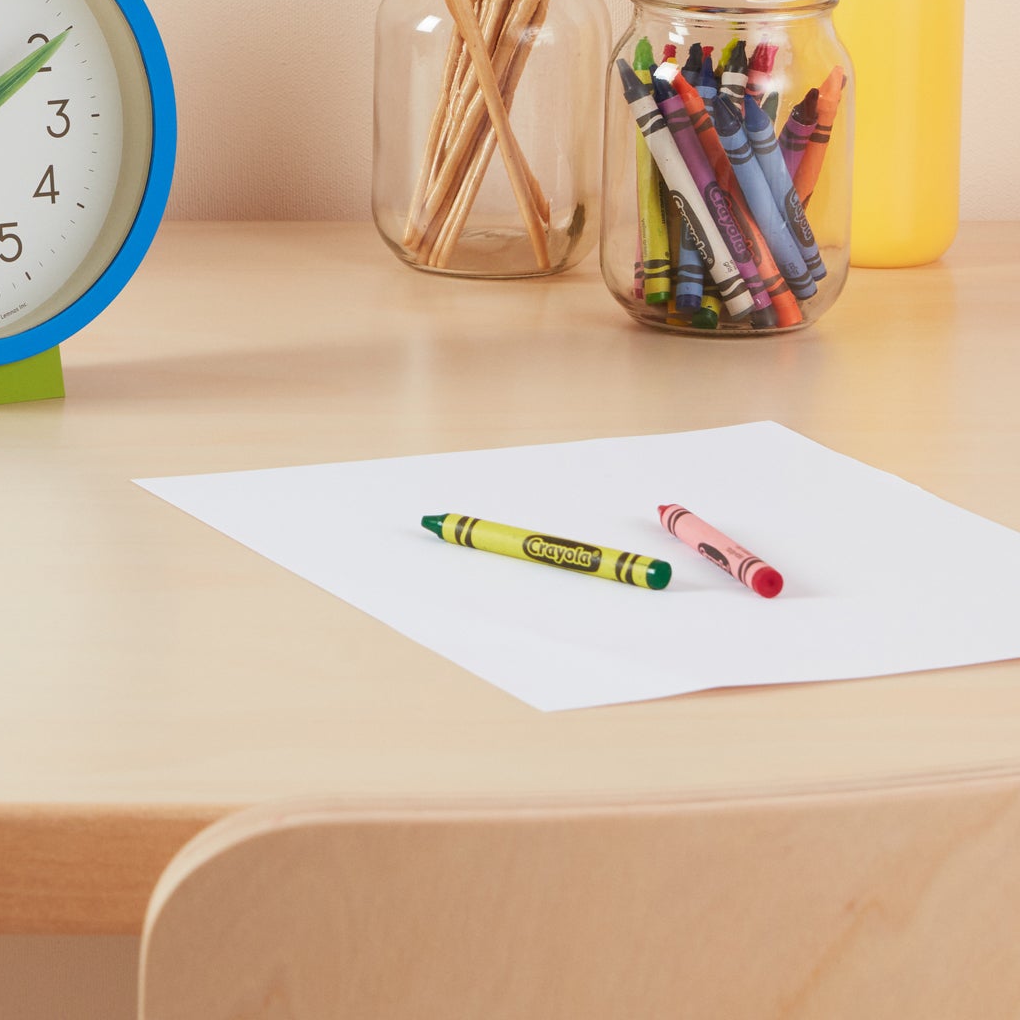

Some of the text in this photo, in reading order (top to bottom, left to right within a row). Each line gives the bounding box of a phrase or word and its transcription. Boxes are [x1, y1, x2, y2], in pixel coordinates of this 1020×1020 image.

[46, 98, 71, 139] 3
[32, 164, 61, 205] 4
[709, 186, 747, 254] Crayola
[789, 188, 812, 241] Crayola
[526, 536, 592, 568] Crayola
